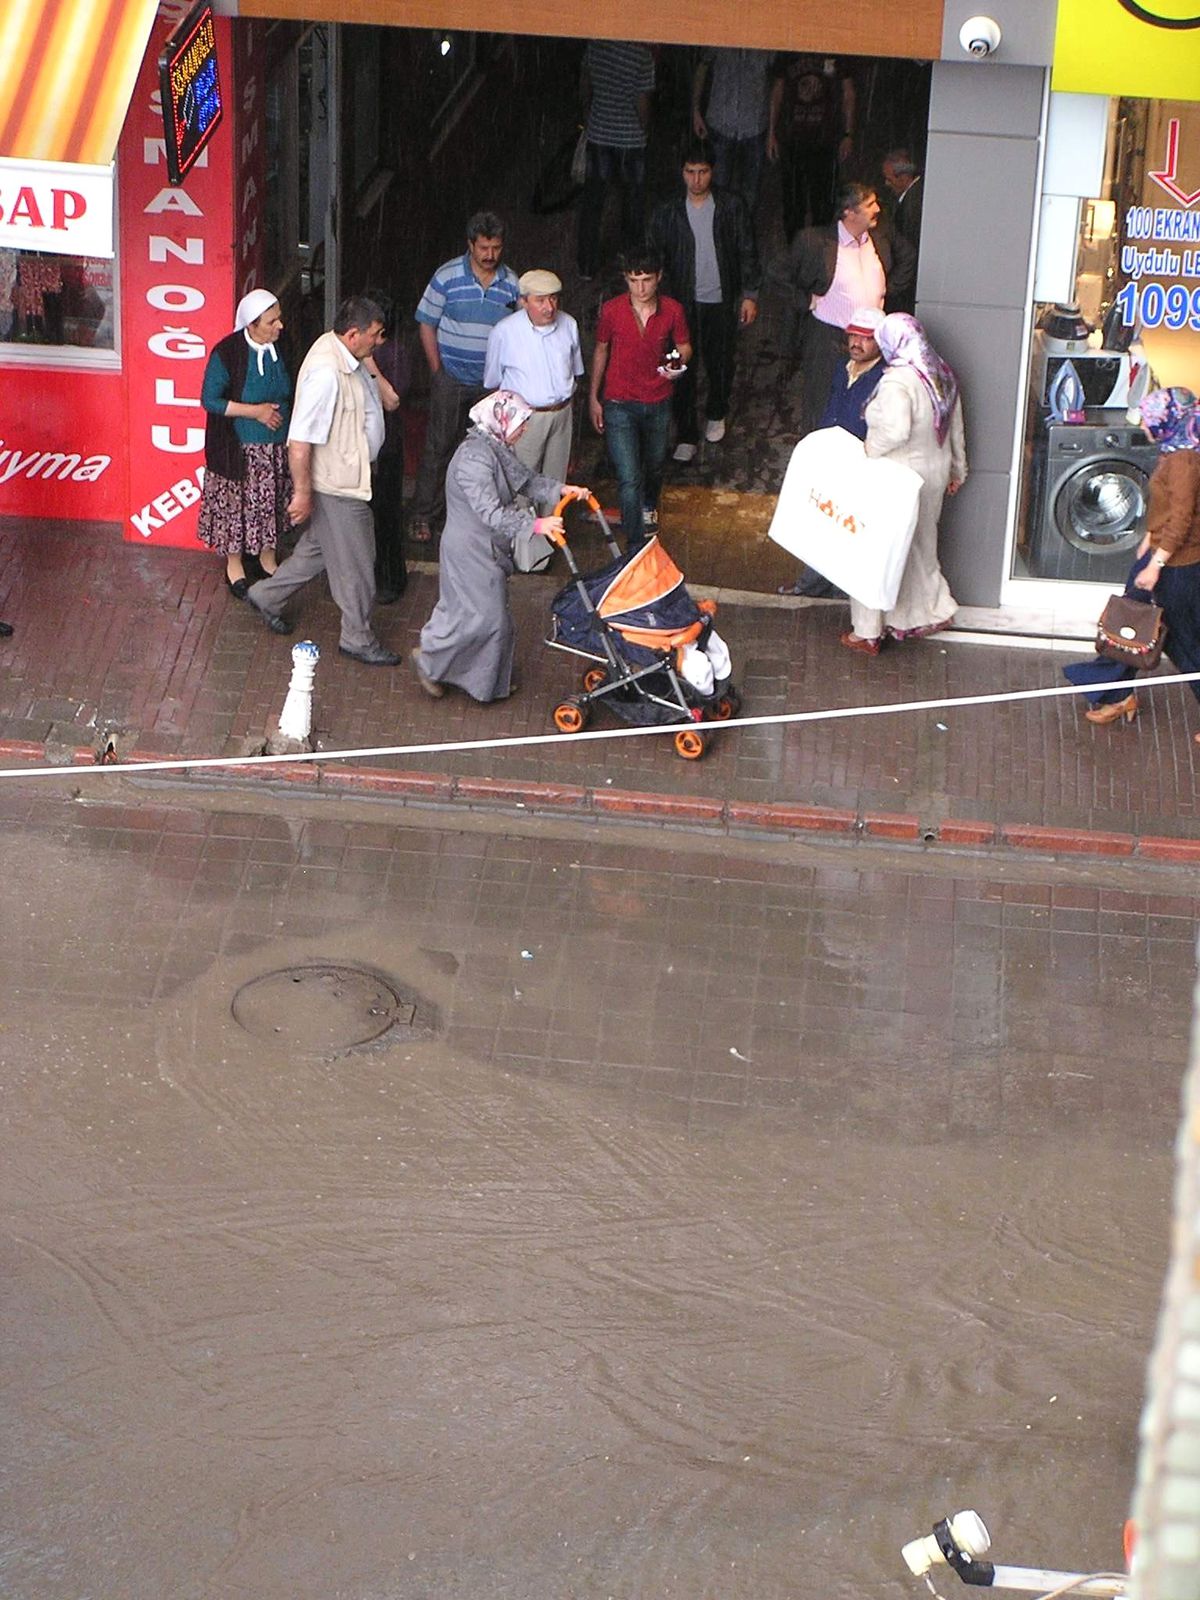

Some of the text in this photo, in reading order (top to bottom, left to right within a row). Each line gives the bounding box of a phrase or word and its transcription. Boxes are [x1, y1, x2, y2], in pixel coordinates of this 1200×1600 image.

[0, 187, 87, 231] AP
[1126, 206, 1152, 239] 100
[1121, 245, 1180, 279] Uydulu
